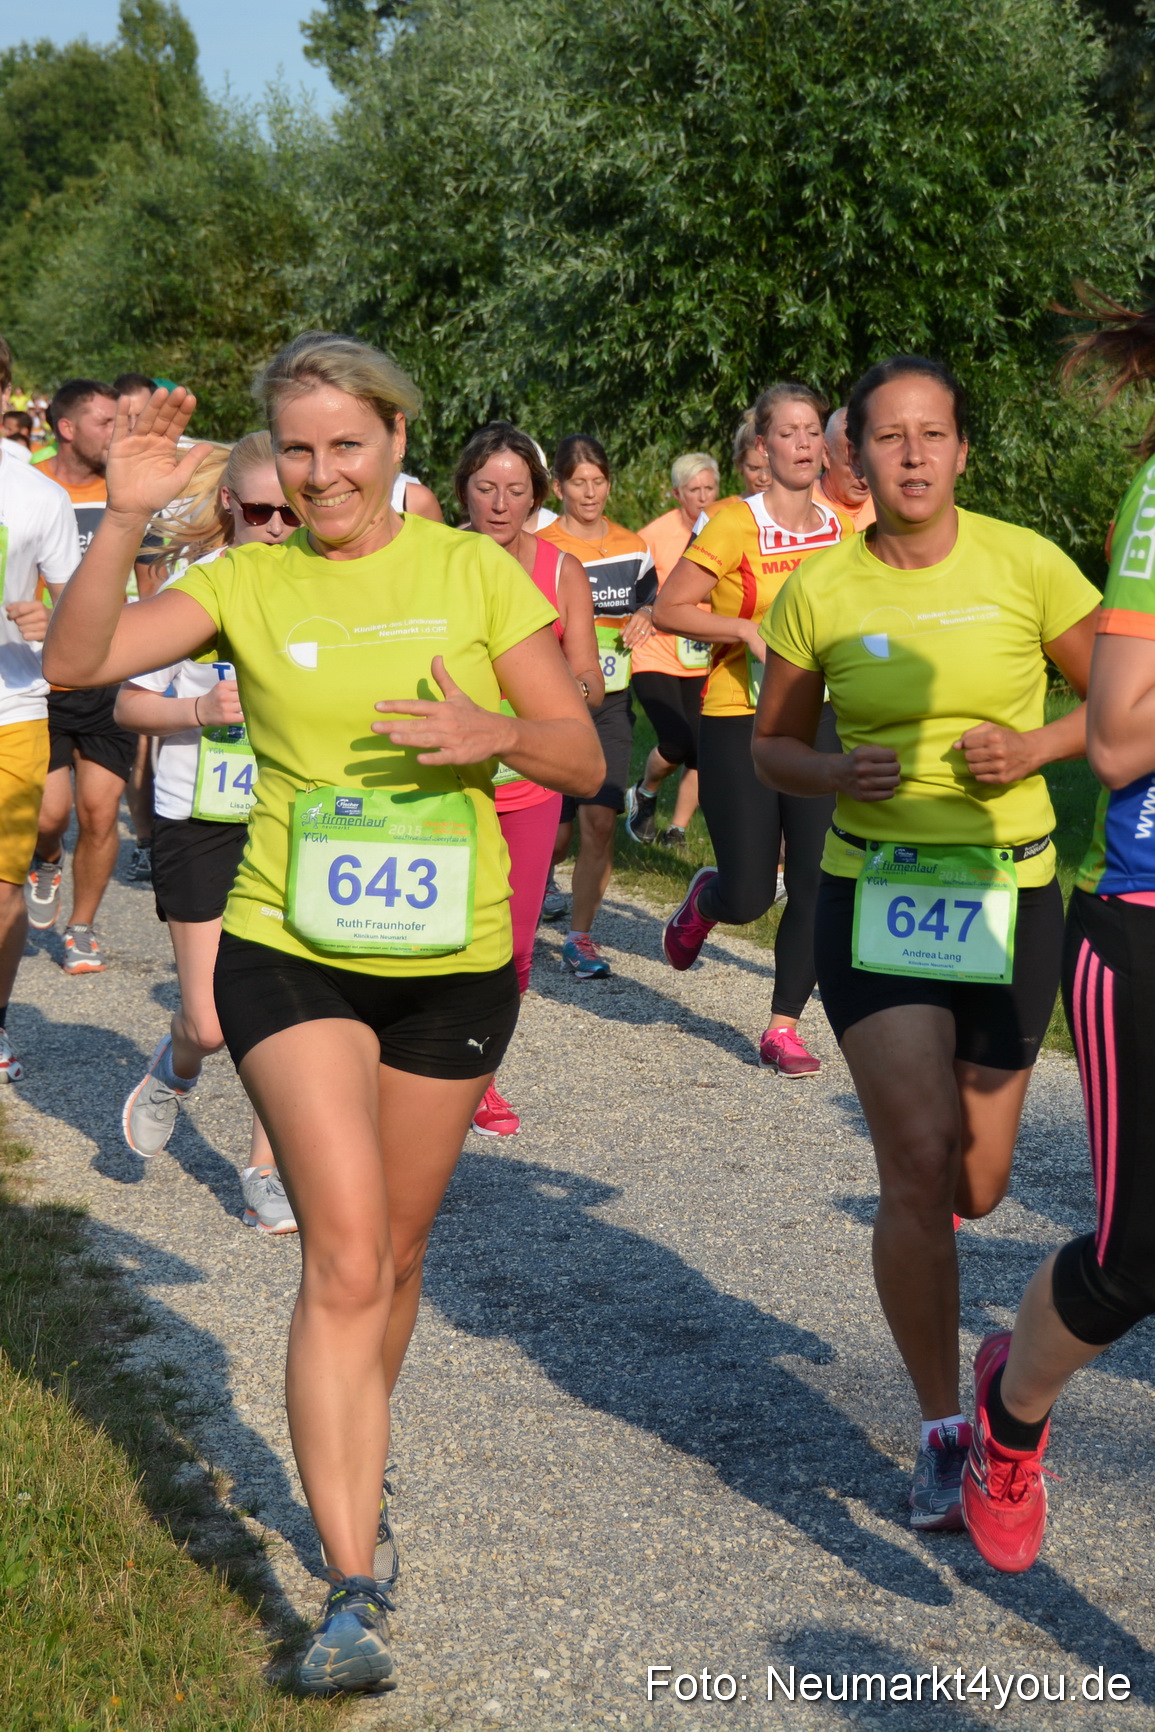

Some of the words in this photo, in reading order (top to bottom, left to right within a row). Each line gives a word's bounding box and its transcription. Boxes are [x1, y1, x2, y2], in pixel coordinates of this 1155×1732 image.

[761, 558, 802, 575] MAX
[354, 623, 387, 633] Kliniken
[389, 621, 402, 629] des
[403, 618, 448, 626] Landkreises
[939, 614, 975, 625] Neumarkt
[379, 627, 419, 637] Neumarkt
[230, 801, 244, 809] Lisa
[322, 812, 388, 828] firmenlauf
[388, 824, 423, 836] 2015
[882, 860, 938, 874] firmenlauf
[328, 854, 438, 910] 643
[938, 870, 967, 881] 2015
[336, 918, 363, 929] Ruth
[365, 920, 426, 931] Fraunhofer
[887, 895, 983, 942] 647
[902, 948, 937, 959] Andrea
[938, 951, 962, 963] Lang
